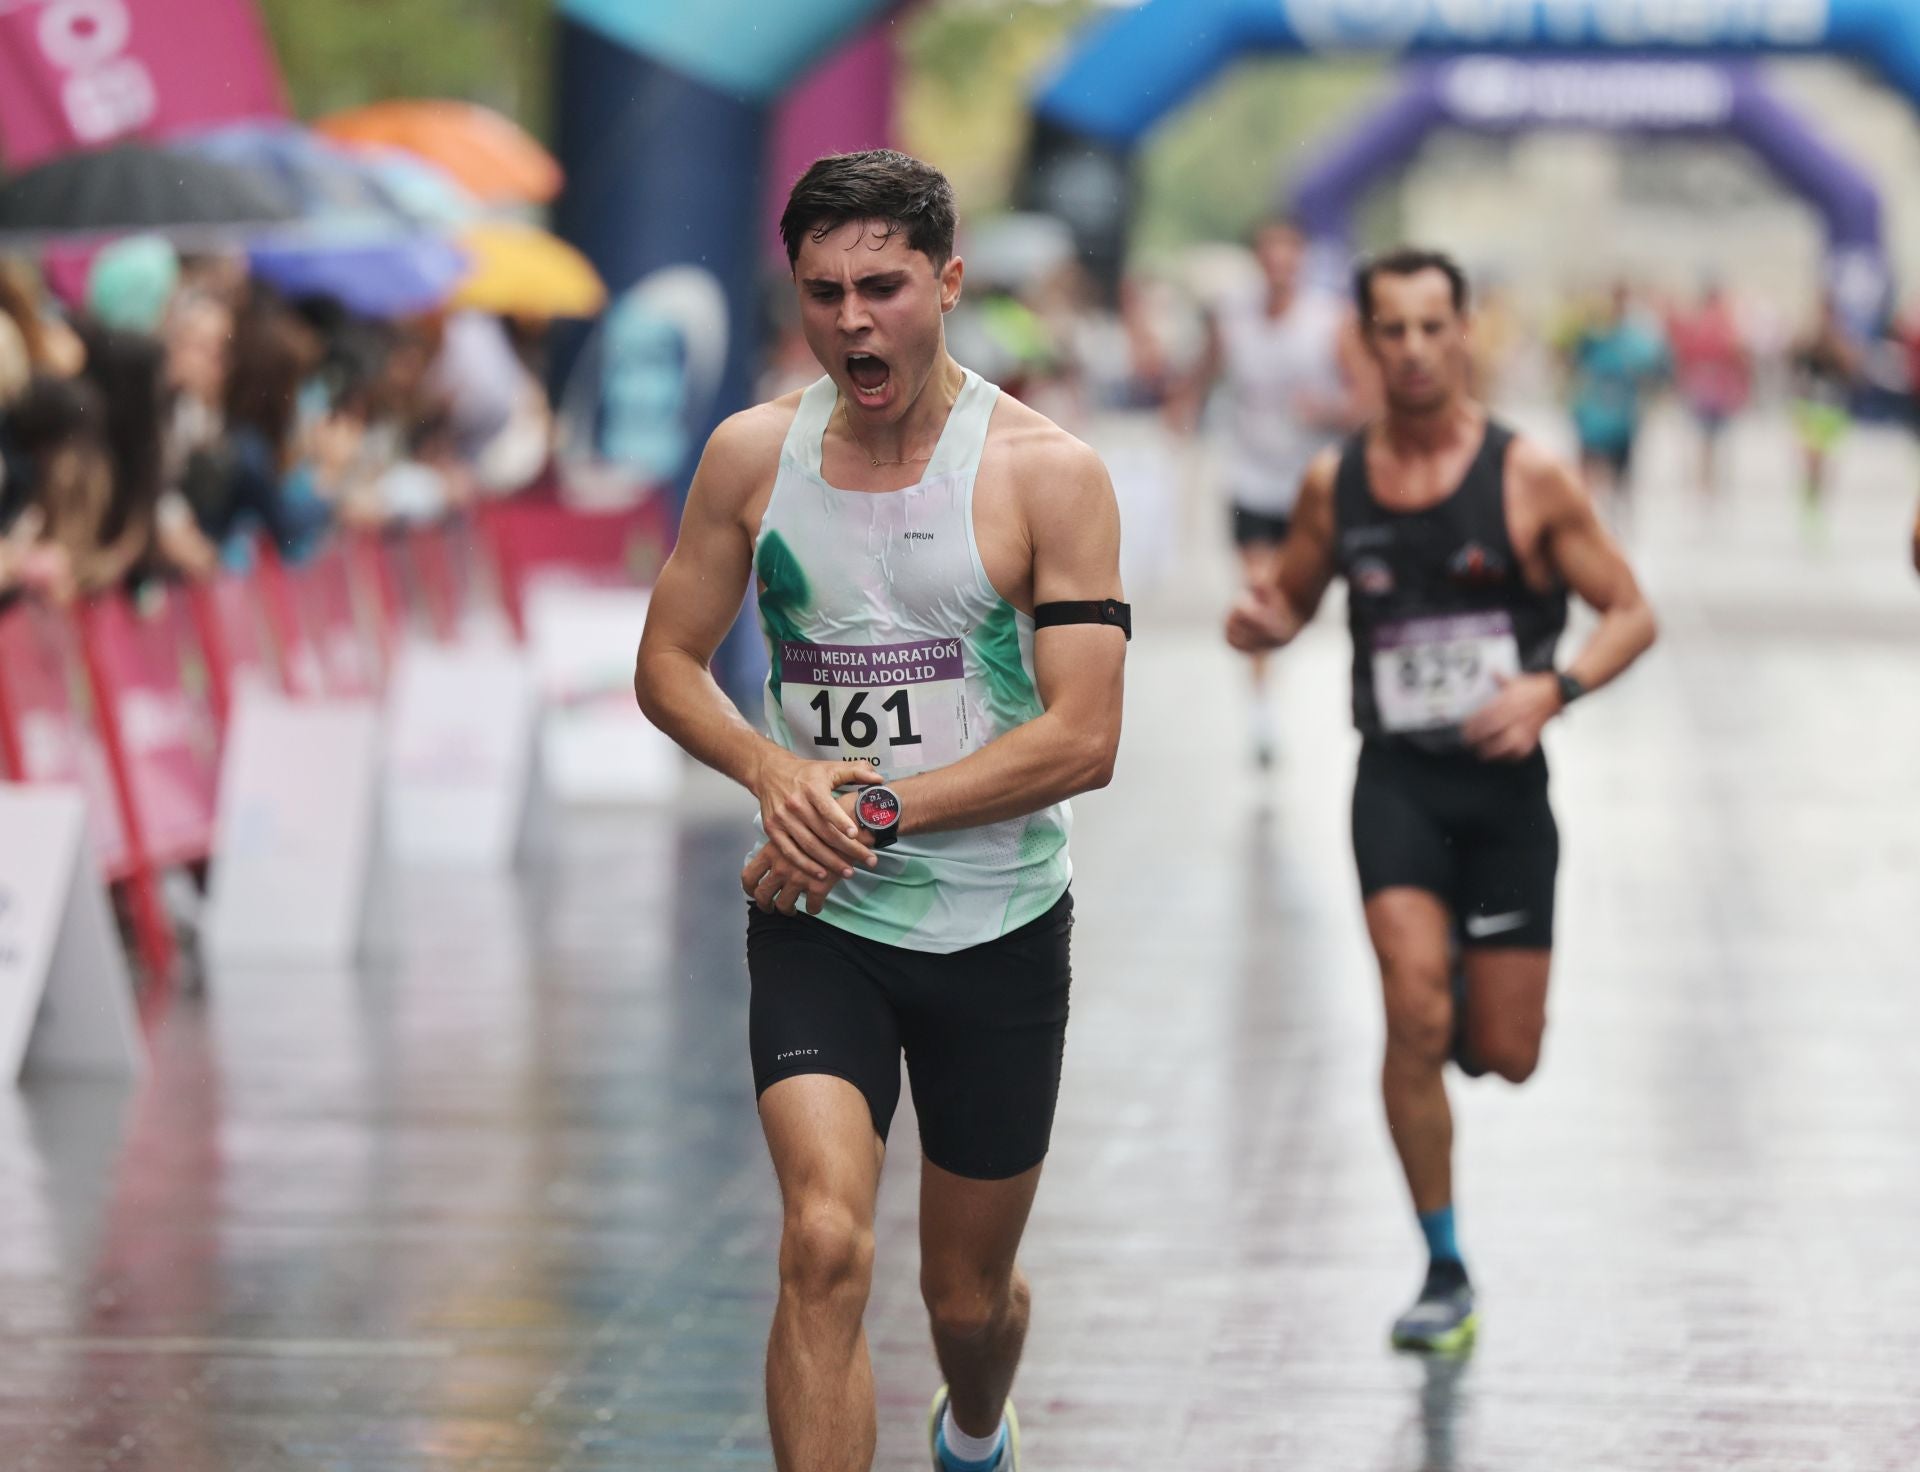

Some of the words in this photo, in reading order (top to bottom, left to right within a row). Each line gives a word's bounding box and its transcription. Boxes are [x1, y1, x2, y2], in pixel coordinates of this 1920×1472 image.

[904, 532, 934, 540] KIPRUN
[785, 647, 817, 663] XXXVI
[821, 651, 867, 666] MEDIA
[872, 642, 957, 666] MARATÓN
[813, 669, 829, 682] DE
[833, 665, 936, 684] VALLADOLID
[810, 689, 922, 748] 161
[777, 1049, 819, 1060] EVADICT
